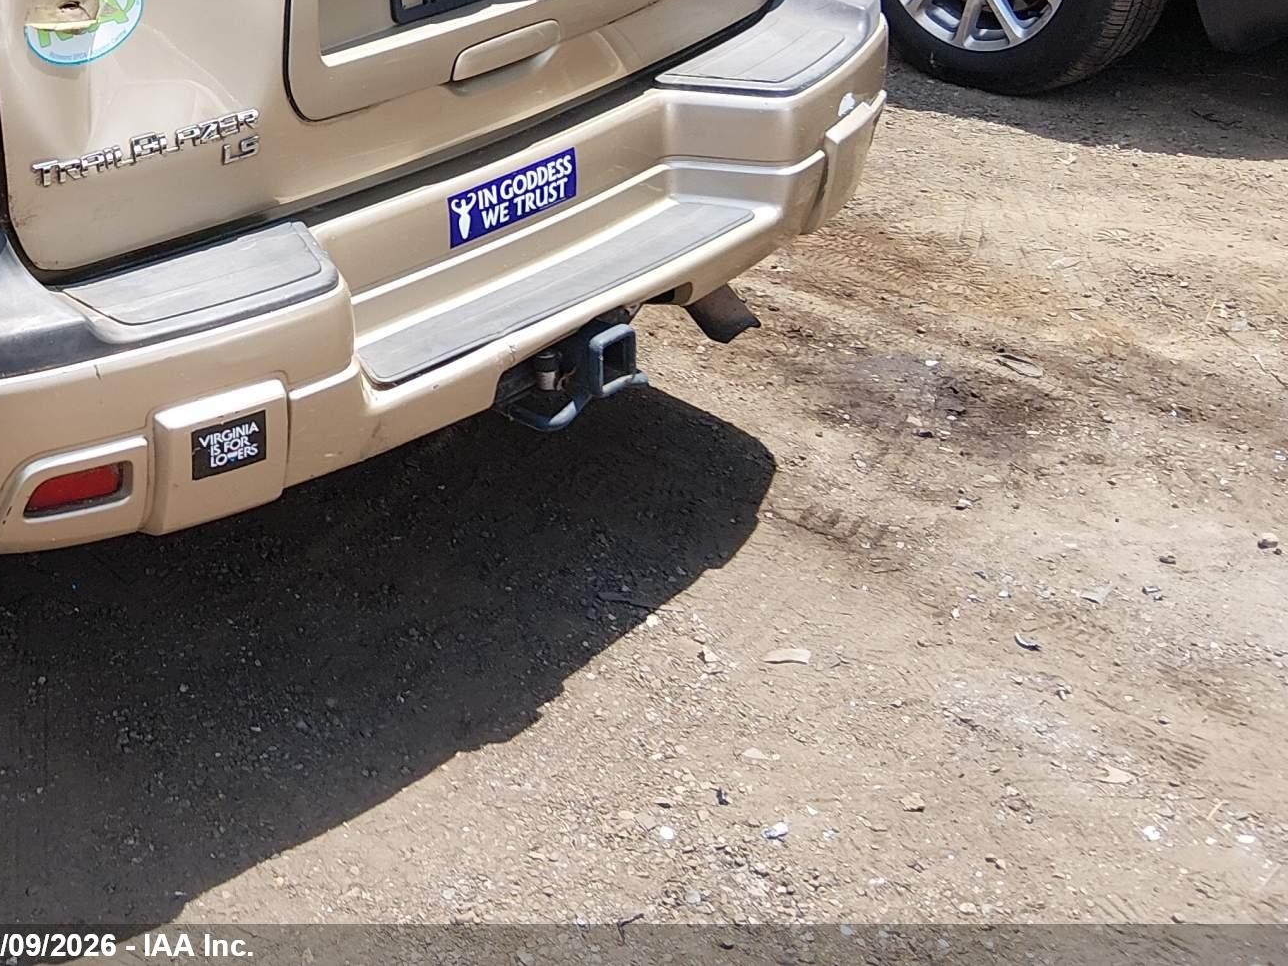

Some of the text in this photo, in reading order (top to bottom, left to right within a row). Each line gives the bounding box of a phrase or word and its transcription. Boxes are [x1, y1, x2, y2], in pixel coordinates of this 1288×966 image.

[222, 135, 259, 166] LS
[477, 154, 573, 210] IN GODDESS
[481, 177, 569, 229] WE TRUST
[198, 421, 260, 448] VIRGINIA
[210, 435, 251, 457] IS FOR
